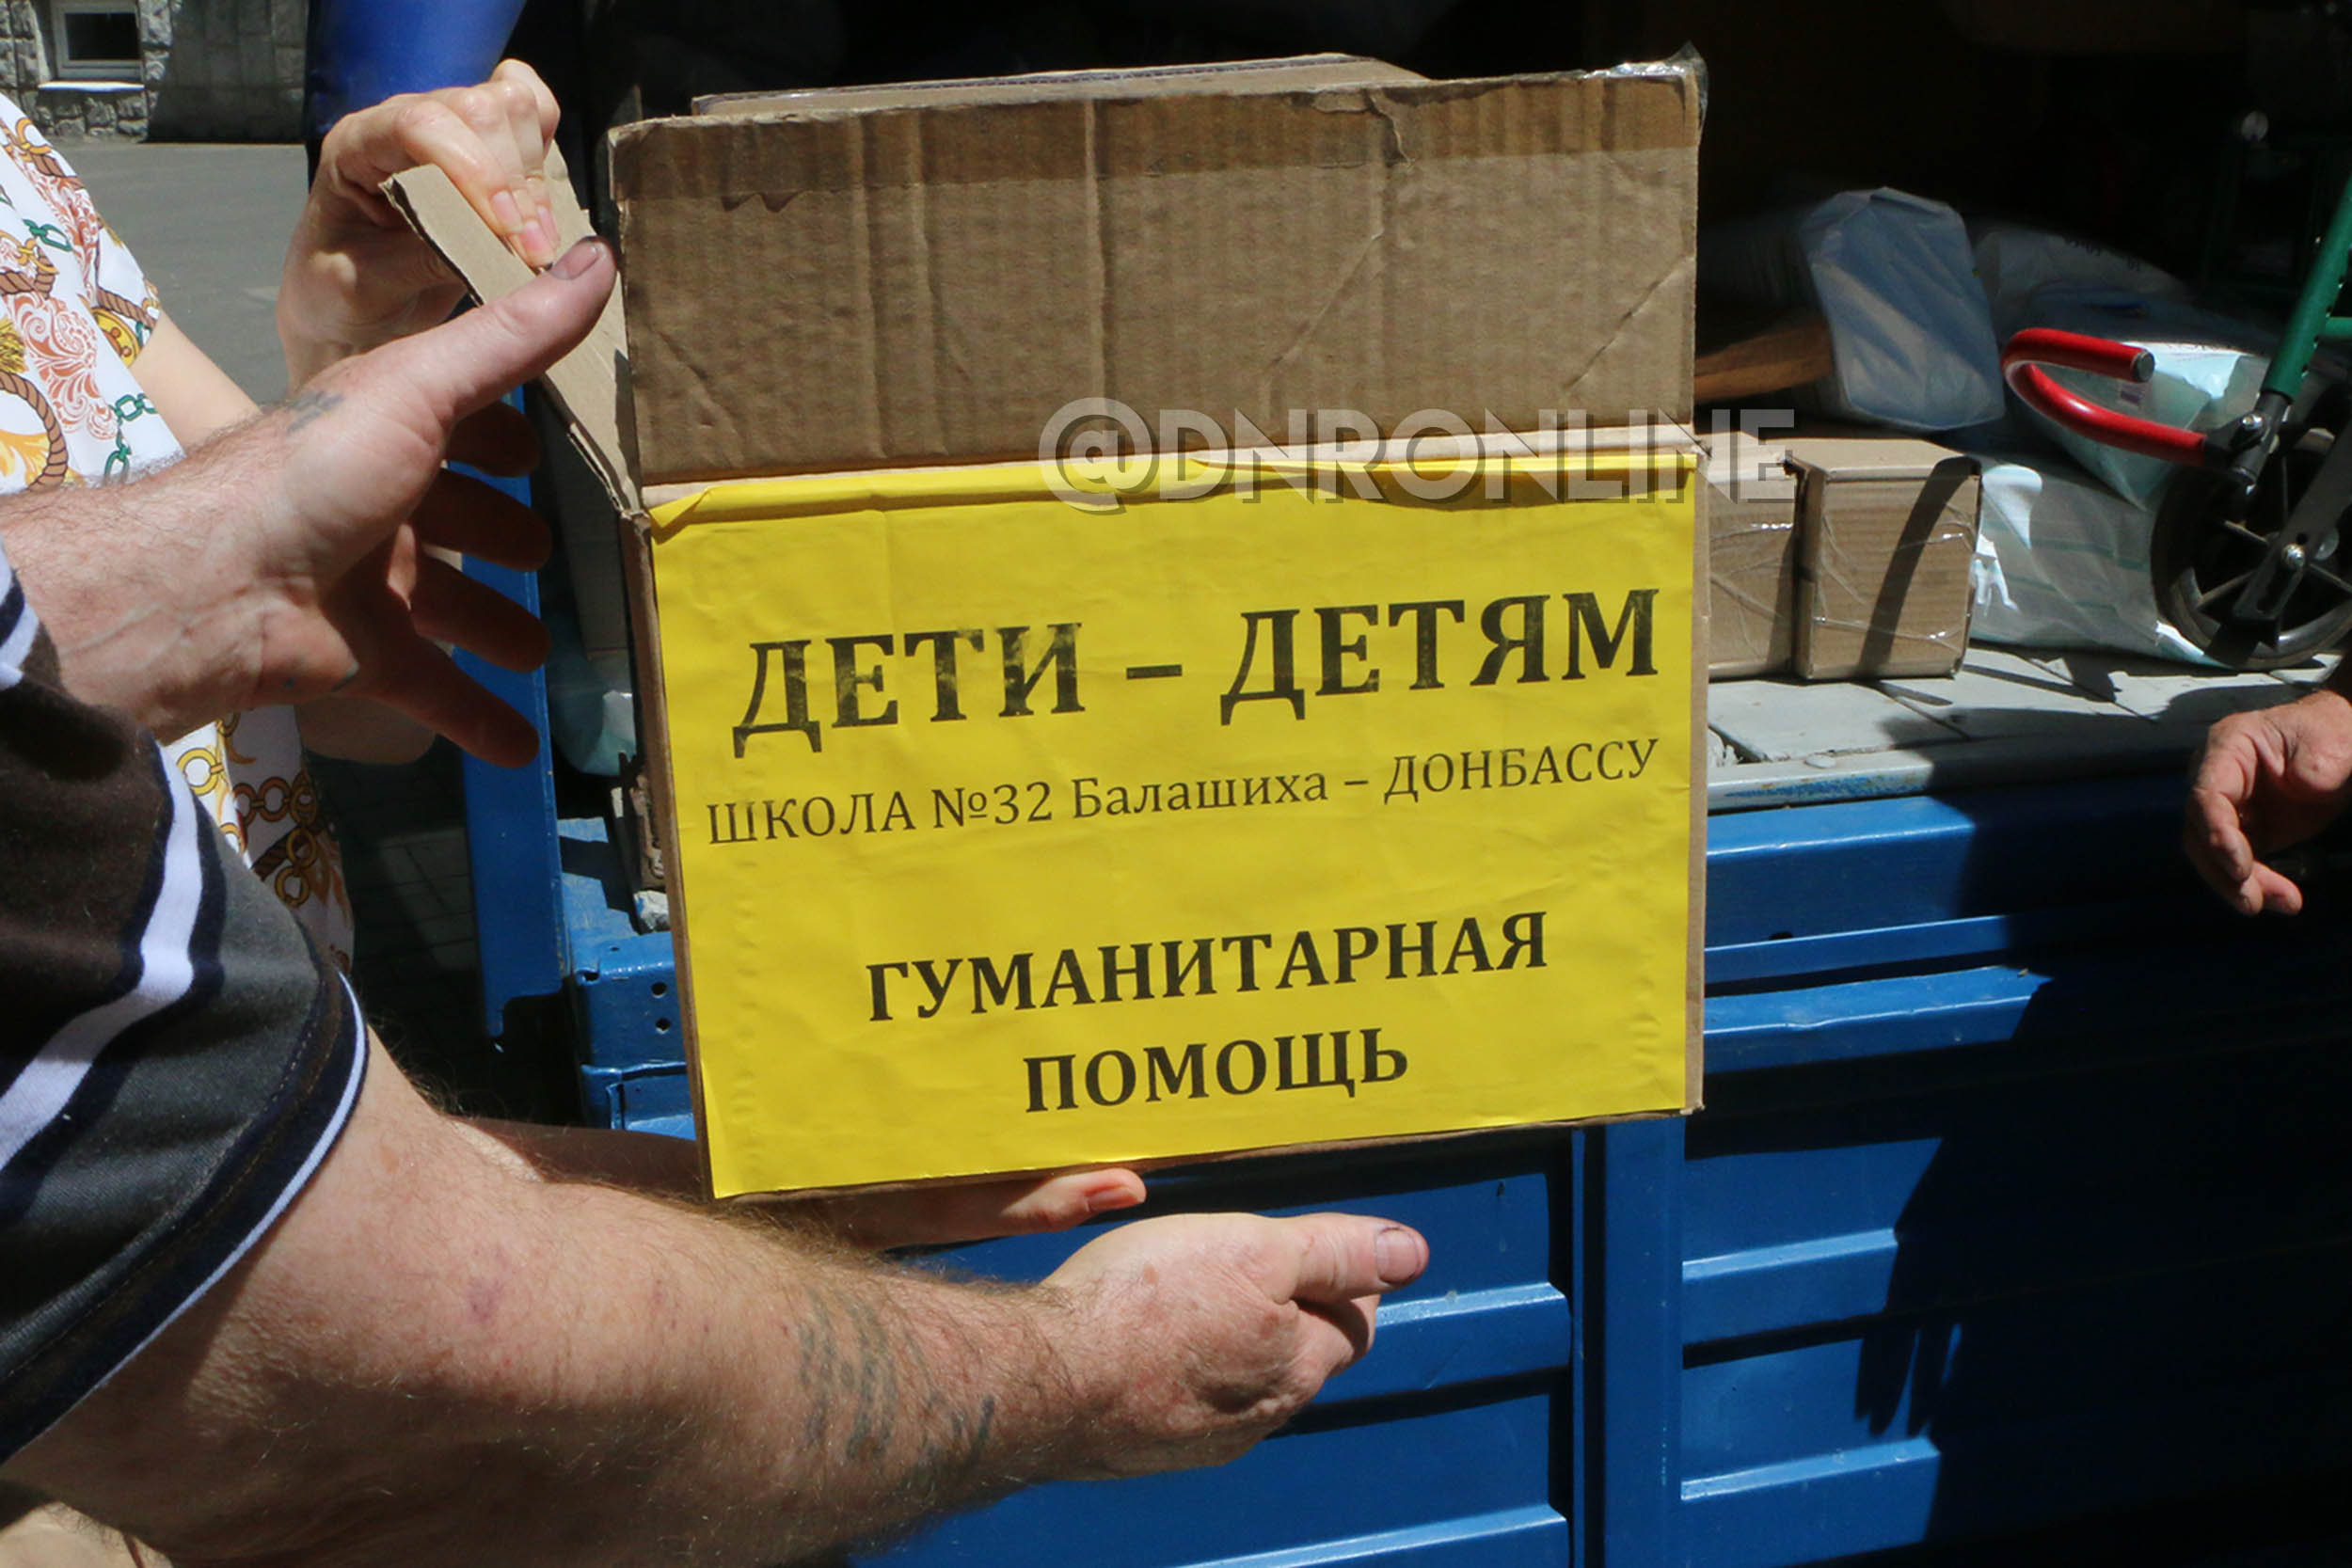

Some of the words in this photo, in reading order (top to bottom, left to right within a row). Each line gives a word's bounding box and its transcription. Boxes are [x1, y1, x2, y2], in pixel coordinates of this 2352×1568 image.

[732, 622, 1086, 758] ДЕТИ
[1219, 588, 1661, 726] ДЕТЯМ
[707, 789, 916, 845] ШКОЛА
[931, 780, 1054, 829] №32
[1071, 770, 1329, 818] Балашиха
[1383, 738, 1660, 805] ДОНБАССУ
[866, 911, 1548, 1022] ГУМАНИТАРНАЯ
[1024, 1027, 1408, 1114] ПОМОЩЬ
